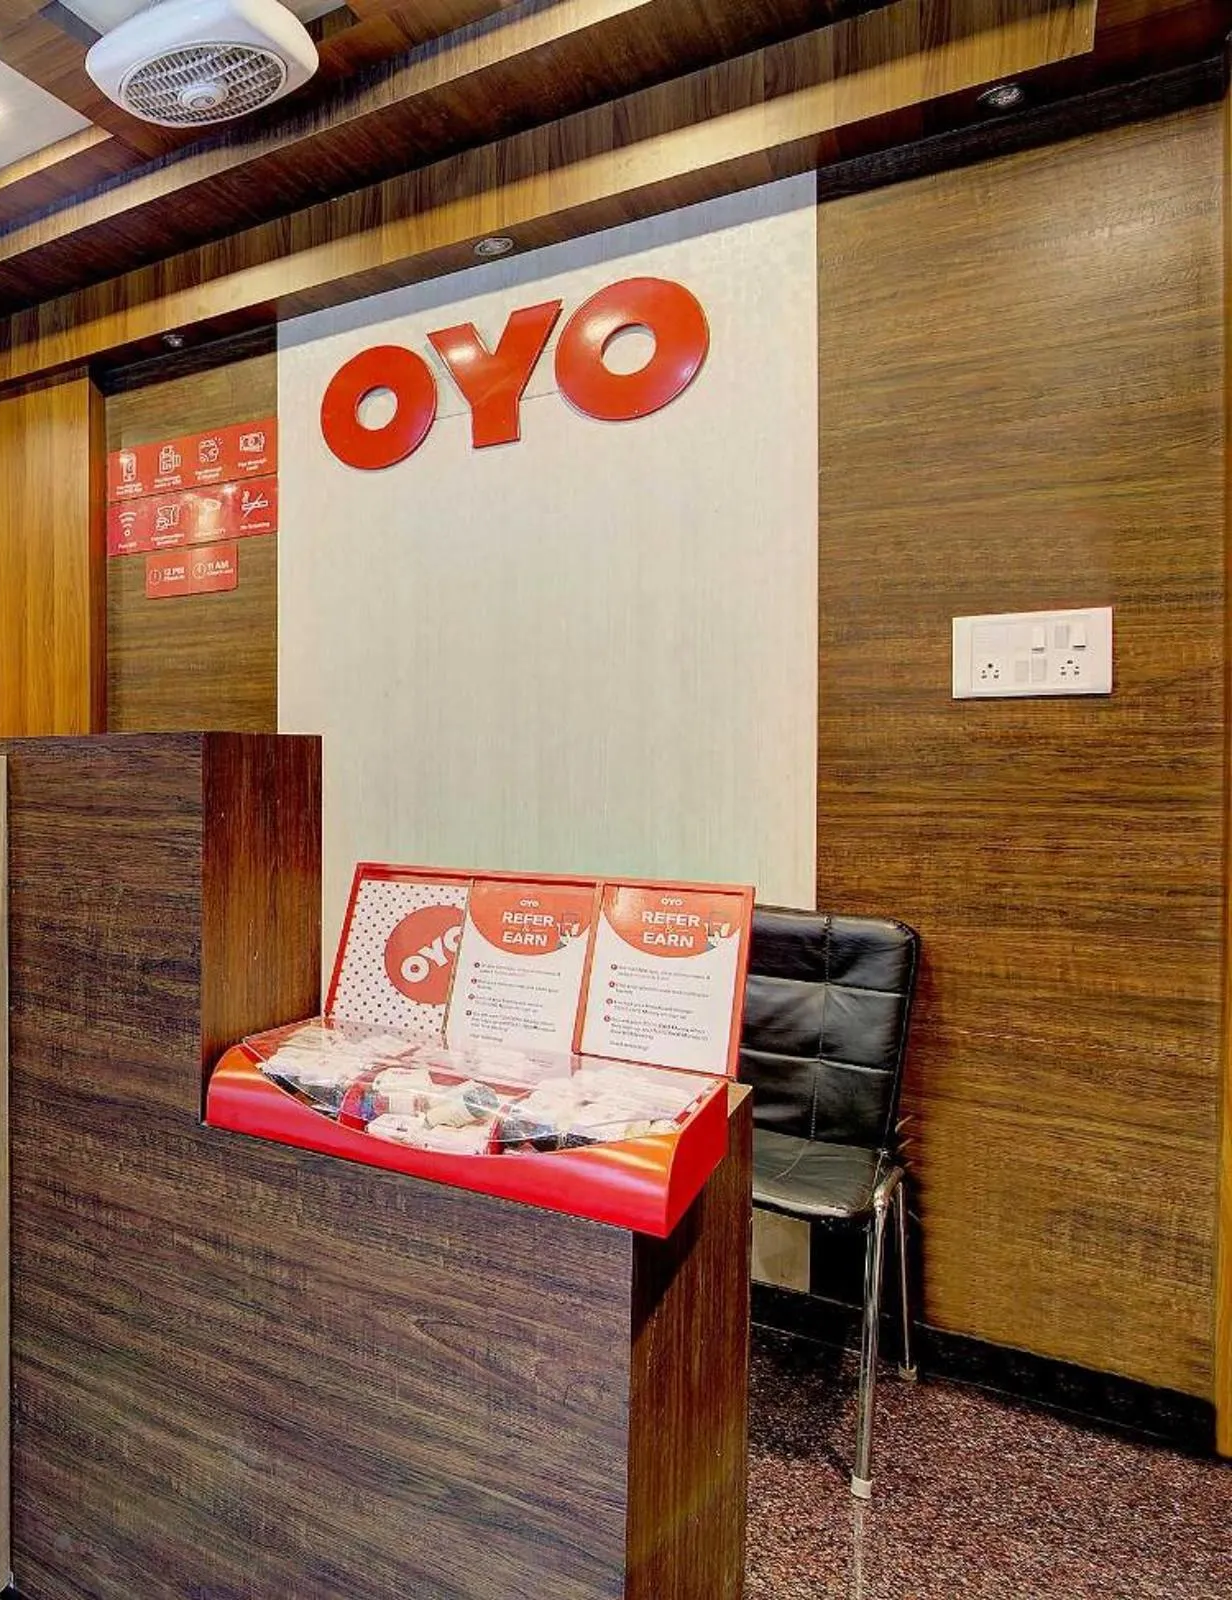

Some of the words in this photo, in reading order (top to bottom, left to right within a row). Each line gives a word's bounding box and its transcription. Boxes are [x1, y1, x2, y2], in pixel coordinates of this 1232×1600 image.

[321, 276, 710, 470] OYO
[519, 899, 540, 908] OYO
[661, 897, 683, 906] OYO
[502, 911, 555, 928] REFER
[641, 911, 701, 928] REFER
[502, 931, 548, 947] EARN
[643, 931, 694, 948] EARN
